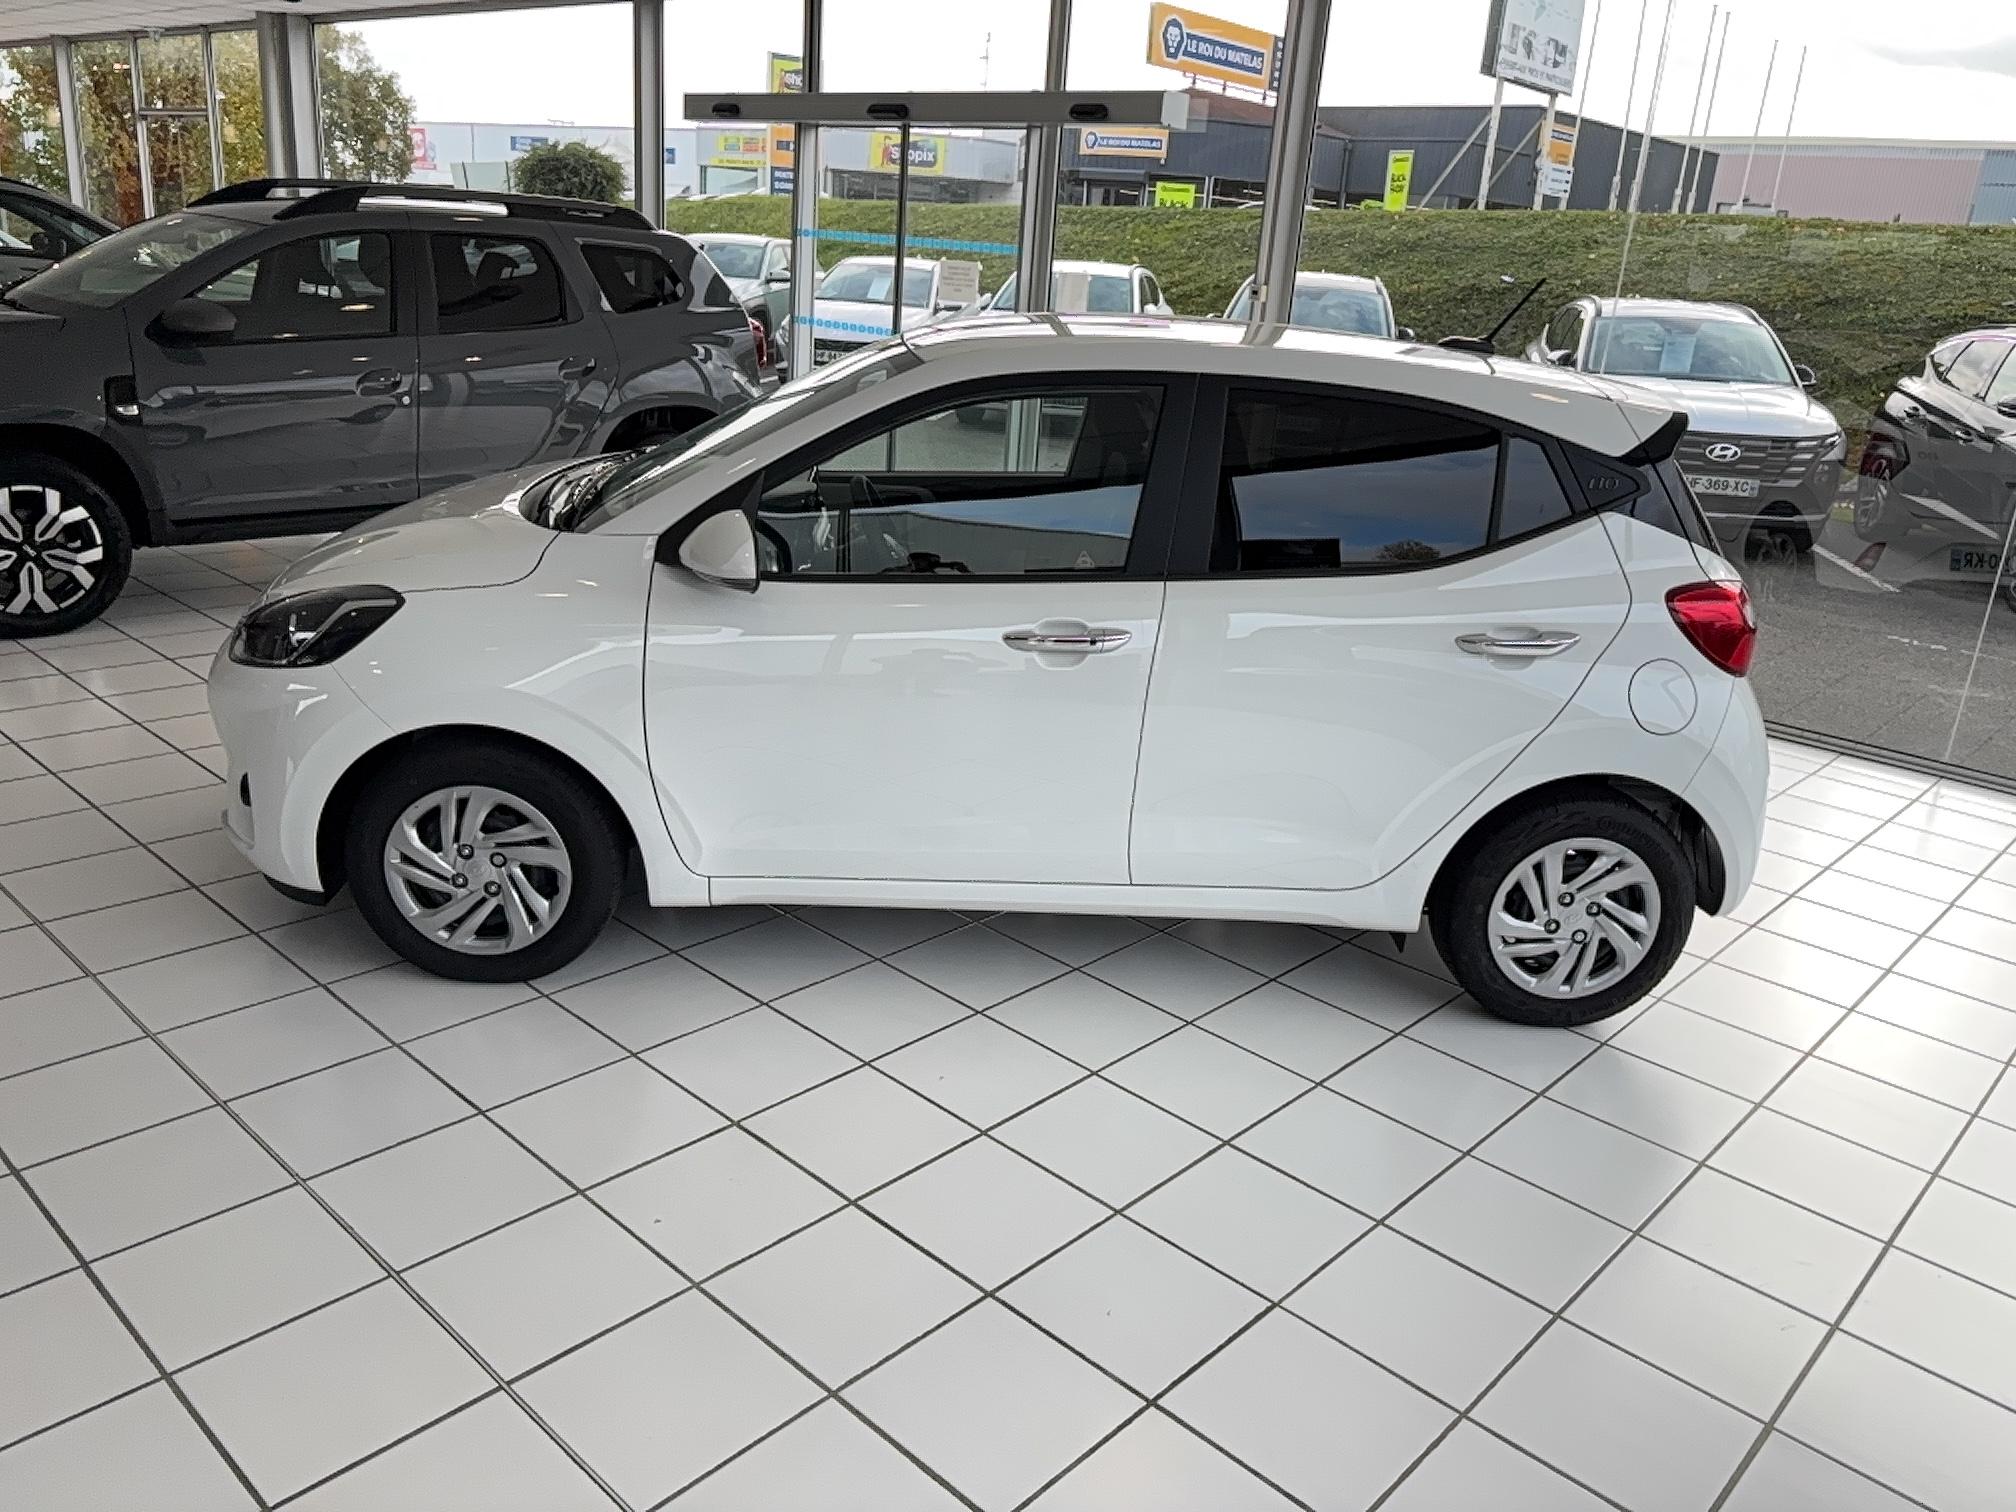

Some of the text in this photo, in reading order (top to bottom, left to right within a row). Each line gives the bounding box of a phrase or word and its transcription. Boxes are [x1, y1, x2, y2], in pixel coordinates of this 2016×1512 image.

[1187, 39, 1264, 70] LE ROI DU MATELAS
